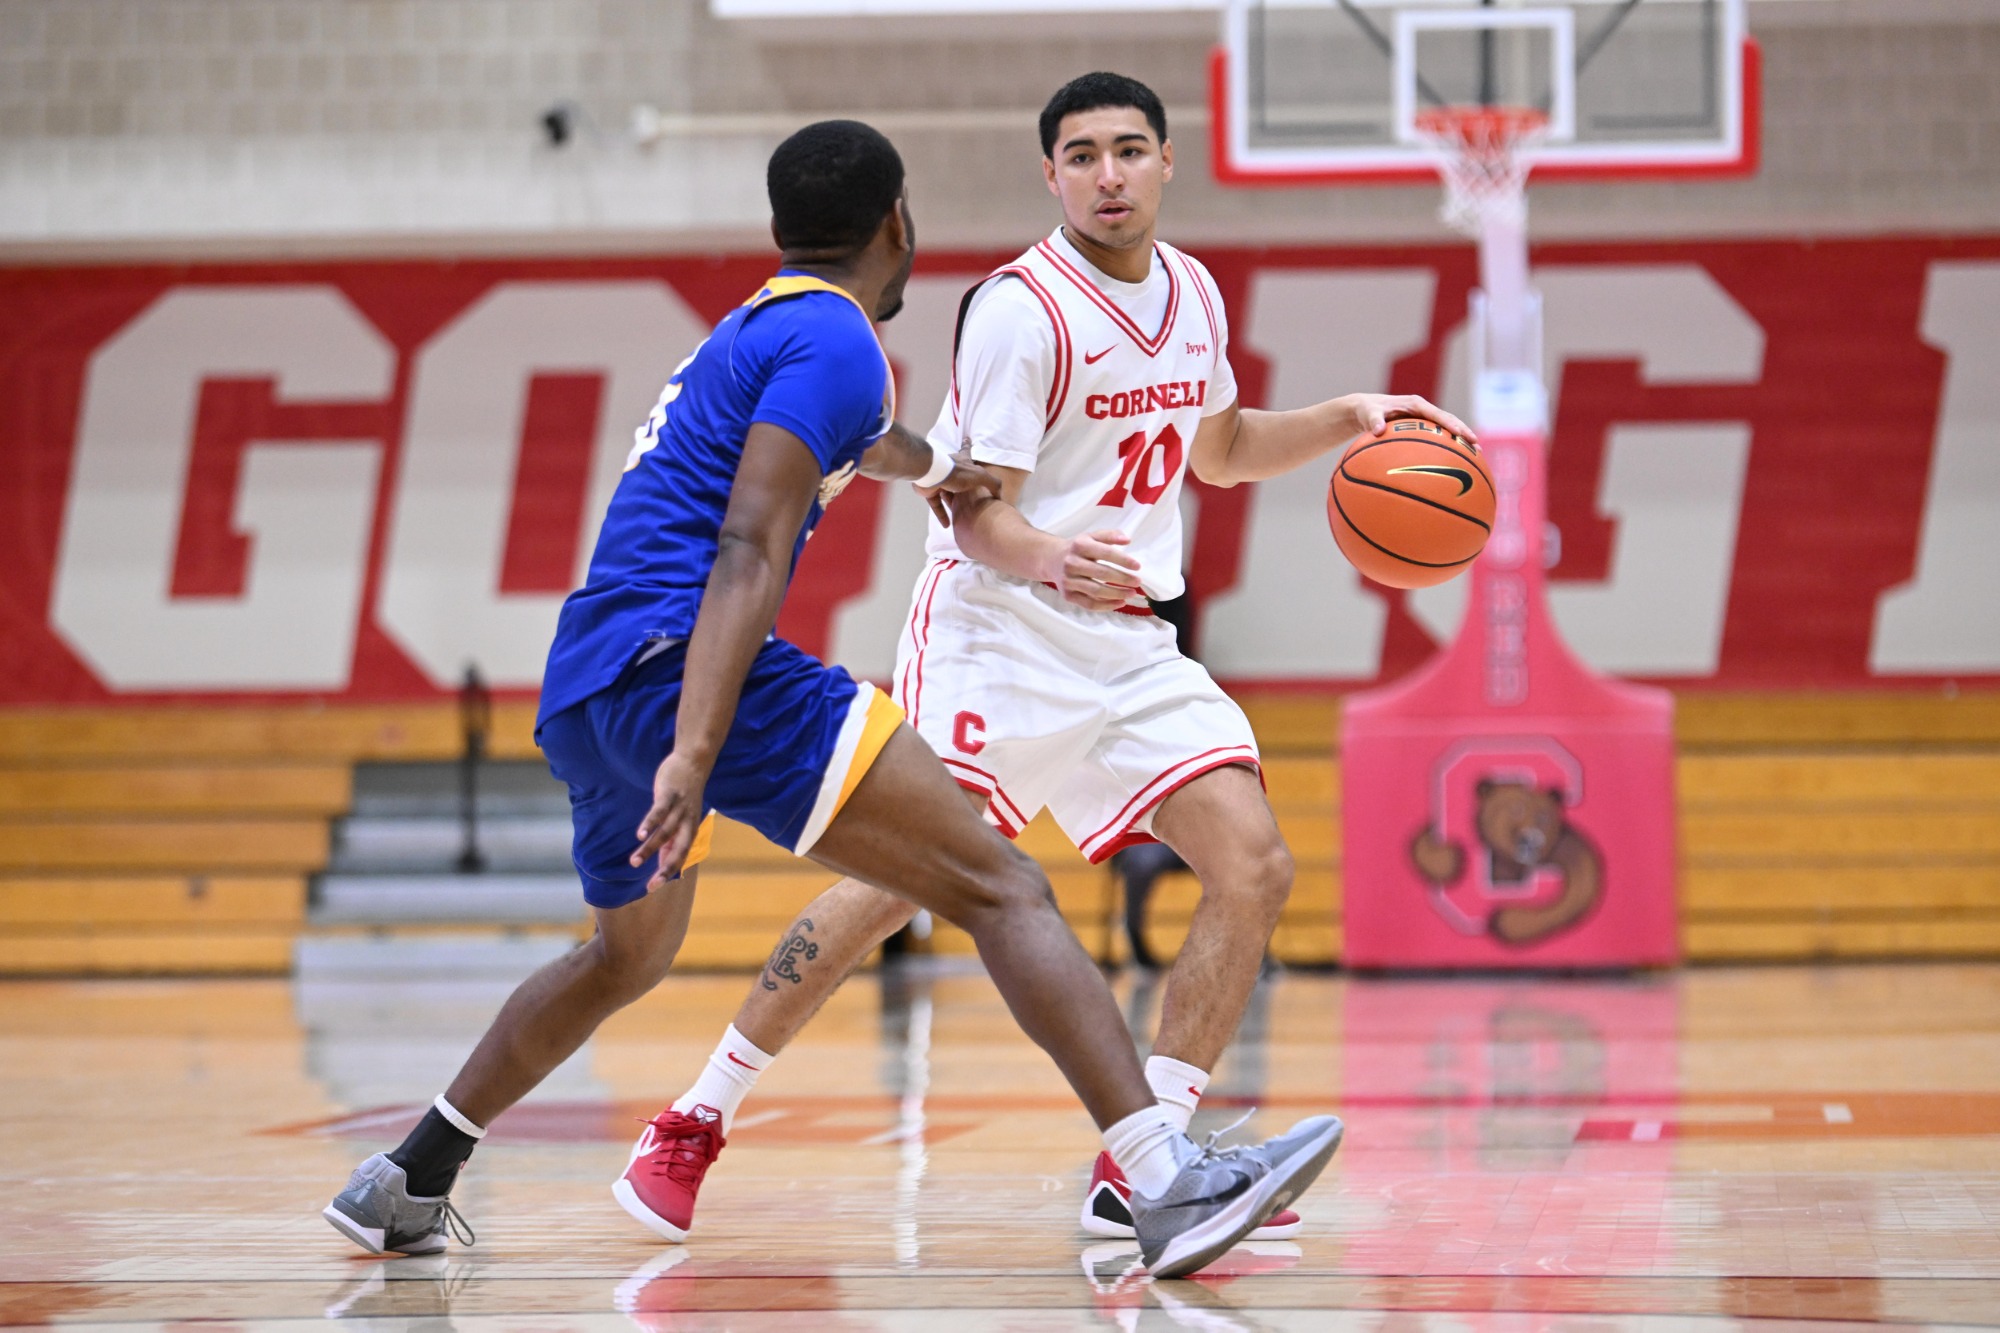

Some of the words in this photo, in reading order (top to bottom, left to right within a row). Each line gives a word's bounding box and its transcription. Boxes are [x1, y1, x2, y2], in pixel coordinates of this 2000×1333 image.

[1185, 342, 1201, 357] Ivy
[48, 280, 718, 692] GO
[1096, 422, 1183, 509] 10
[952, 710, 986, 757] C
